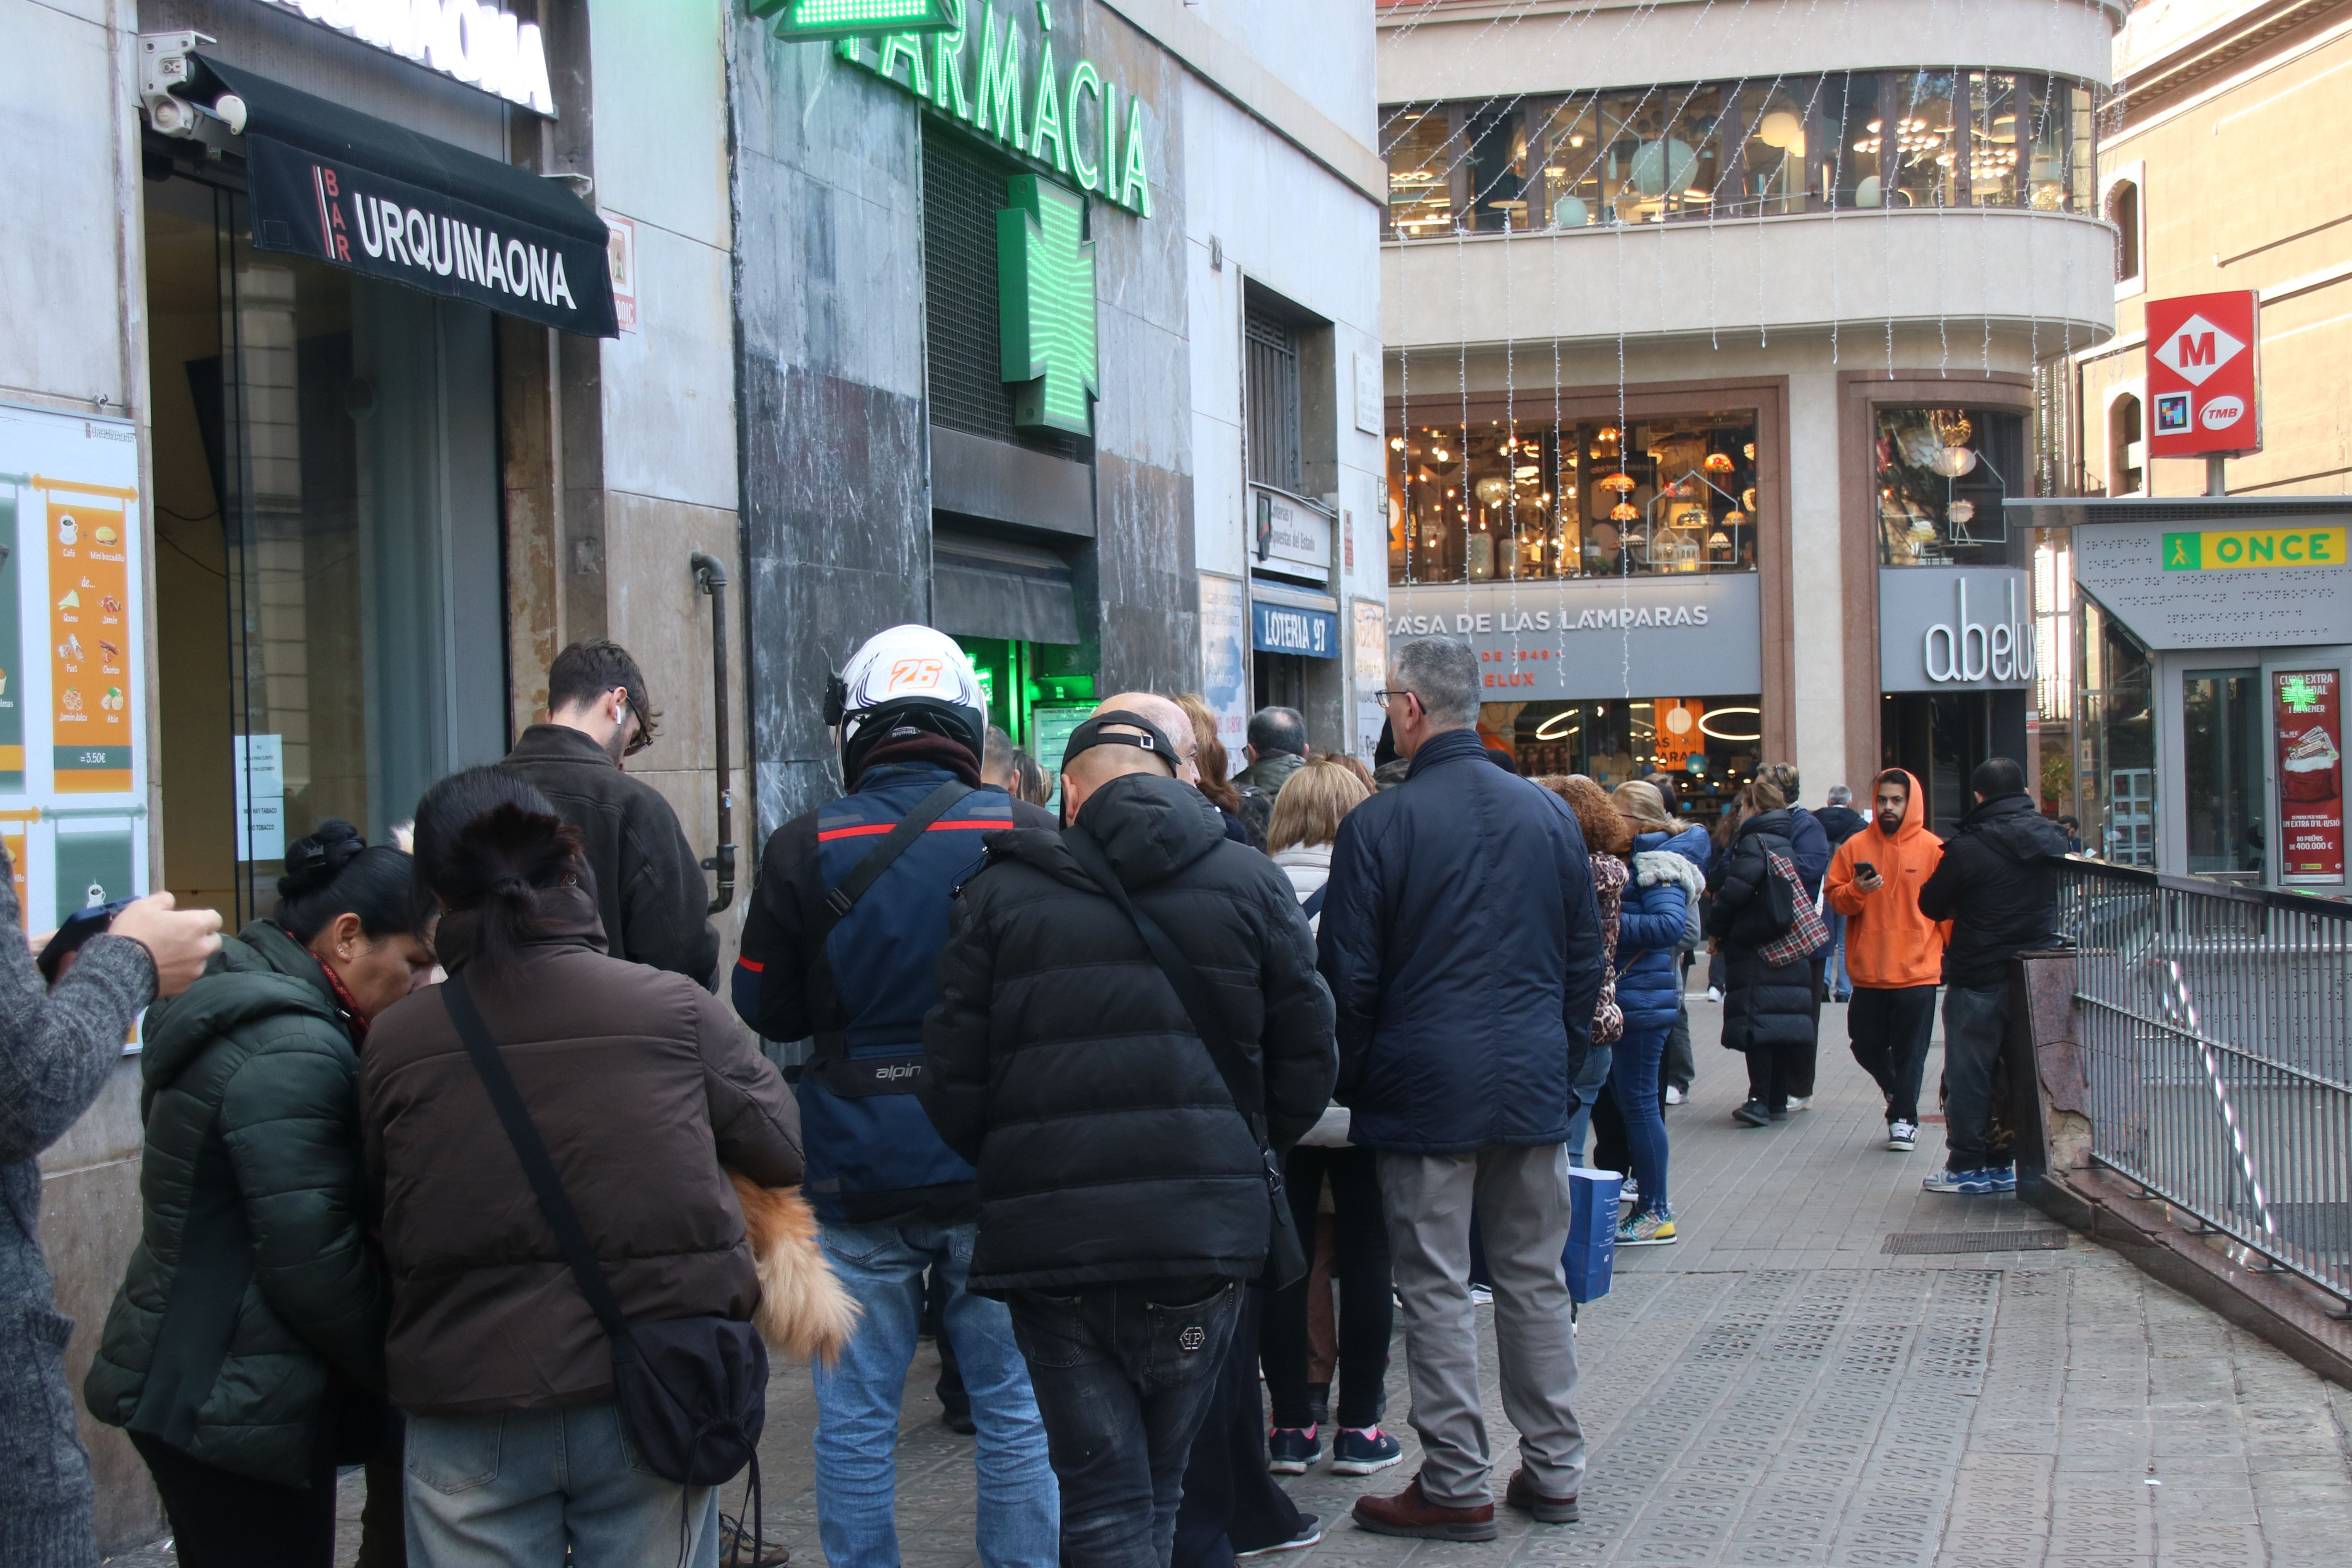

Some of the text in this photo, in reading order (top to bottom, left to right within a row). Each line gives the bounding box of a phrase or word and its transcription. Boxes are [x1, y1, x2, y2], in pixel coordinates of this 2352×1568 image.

[844, 0, 1151, 219] ARMÀCIA
[324, 168, 352, 263] BAR
[354, 193, 577, 310] URQUINAONA
[2178, 332, 2216, 368] M
[2208, 408, 2238, 420] TMB
[63, 548, 76, 558] Café
[2216, 533, 2331, 563] ONCE
[90, 551, 125, 562] Mini bocadillo
[64, 613, 118, 624] Queso Jamón
[1457, 613, 1491, 634] DE
[1501, 611, 1551, 632] LAS
[1265, 610, 1310, 650] LOTERIA
[1314, 618, 1325, 651] 97
[1481, 651, 1503, 661] DE
[67, 664, 119, 674] Fuet Chorizo
[1485, 672, 1535, 687] ELUX
[2305, 674, 2333, 684] EXTRA
[59, 713, 119, 723] Jamón dulce Atún
[86, 753, 106, 763] 3.50€
